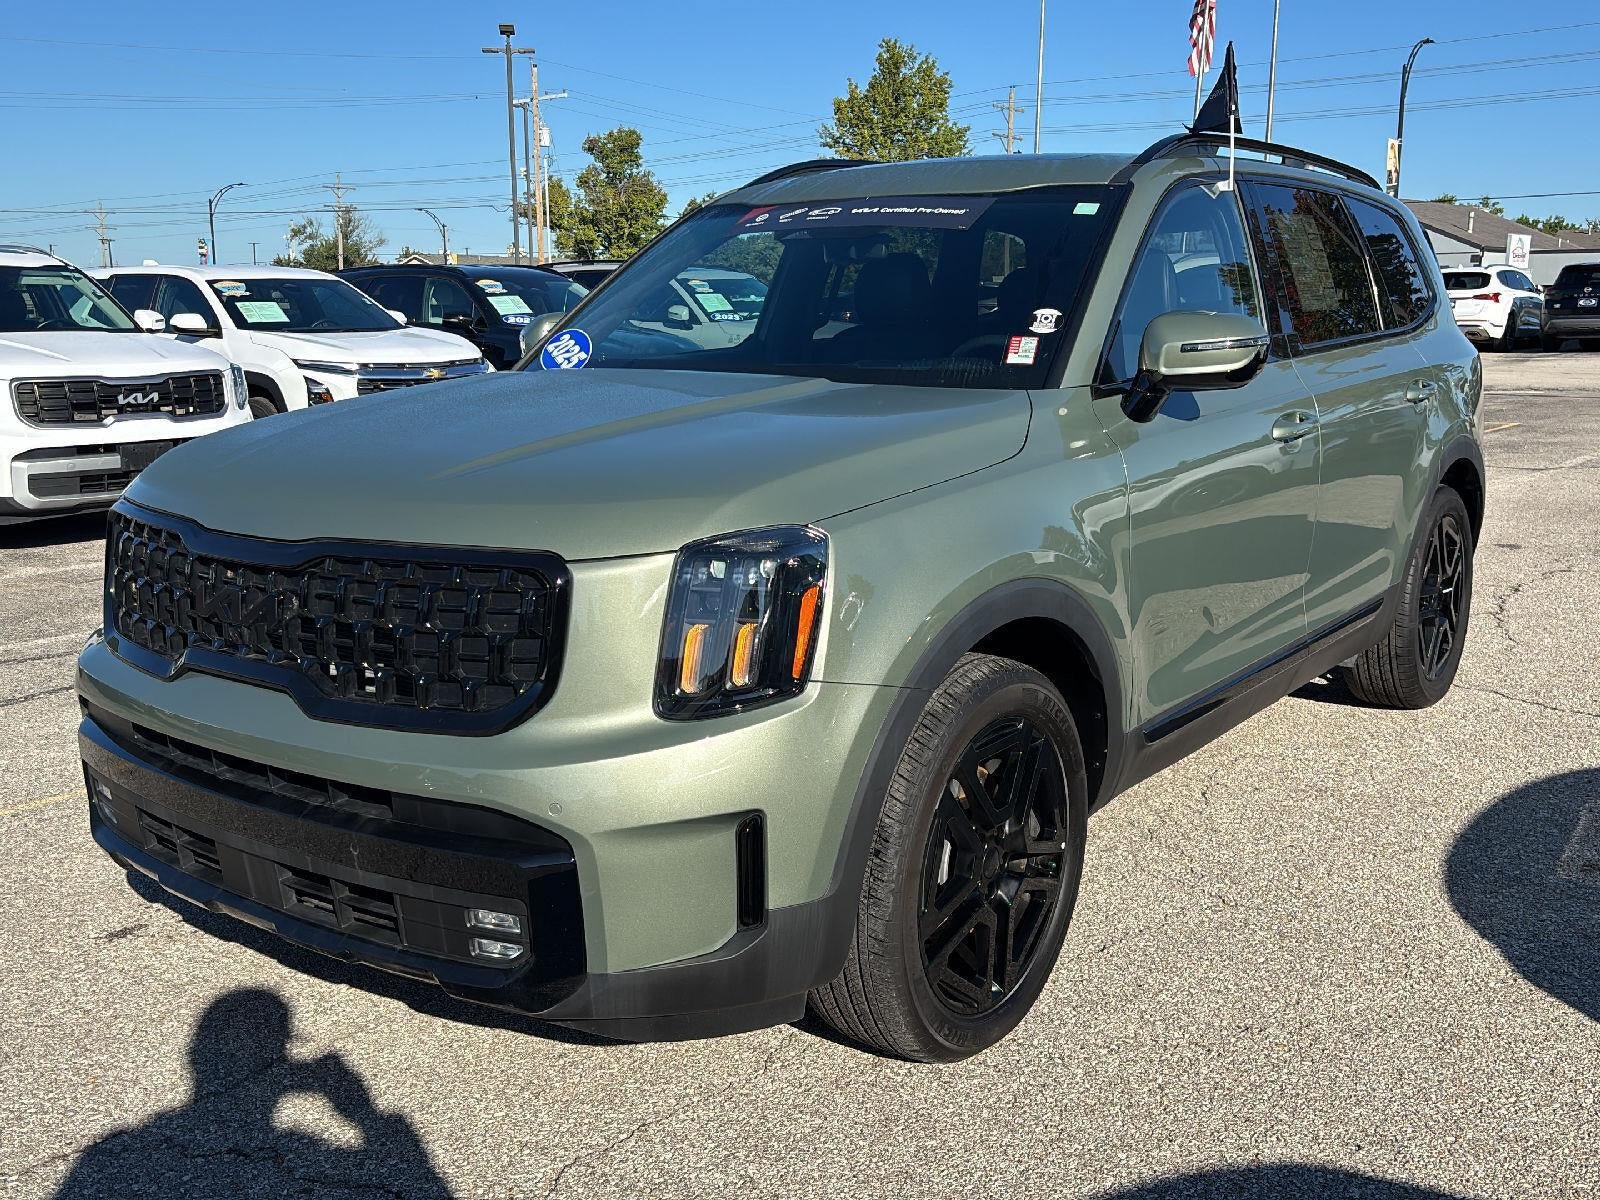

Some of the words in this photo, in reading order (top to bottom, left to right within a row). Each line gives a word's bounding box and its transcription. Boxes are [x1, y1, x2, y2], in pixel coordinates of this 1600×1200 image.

[507, 315, 534, 325] 202
[546, 333, 588, 369] 2025
[117, 392, 160, 405] KIA
